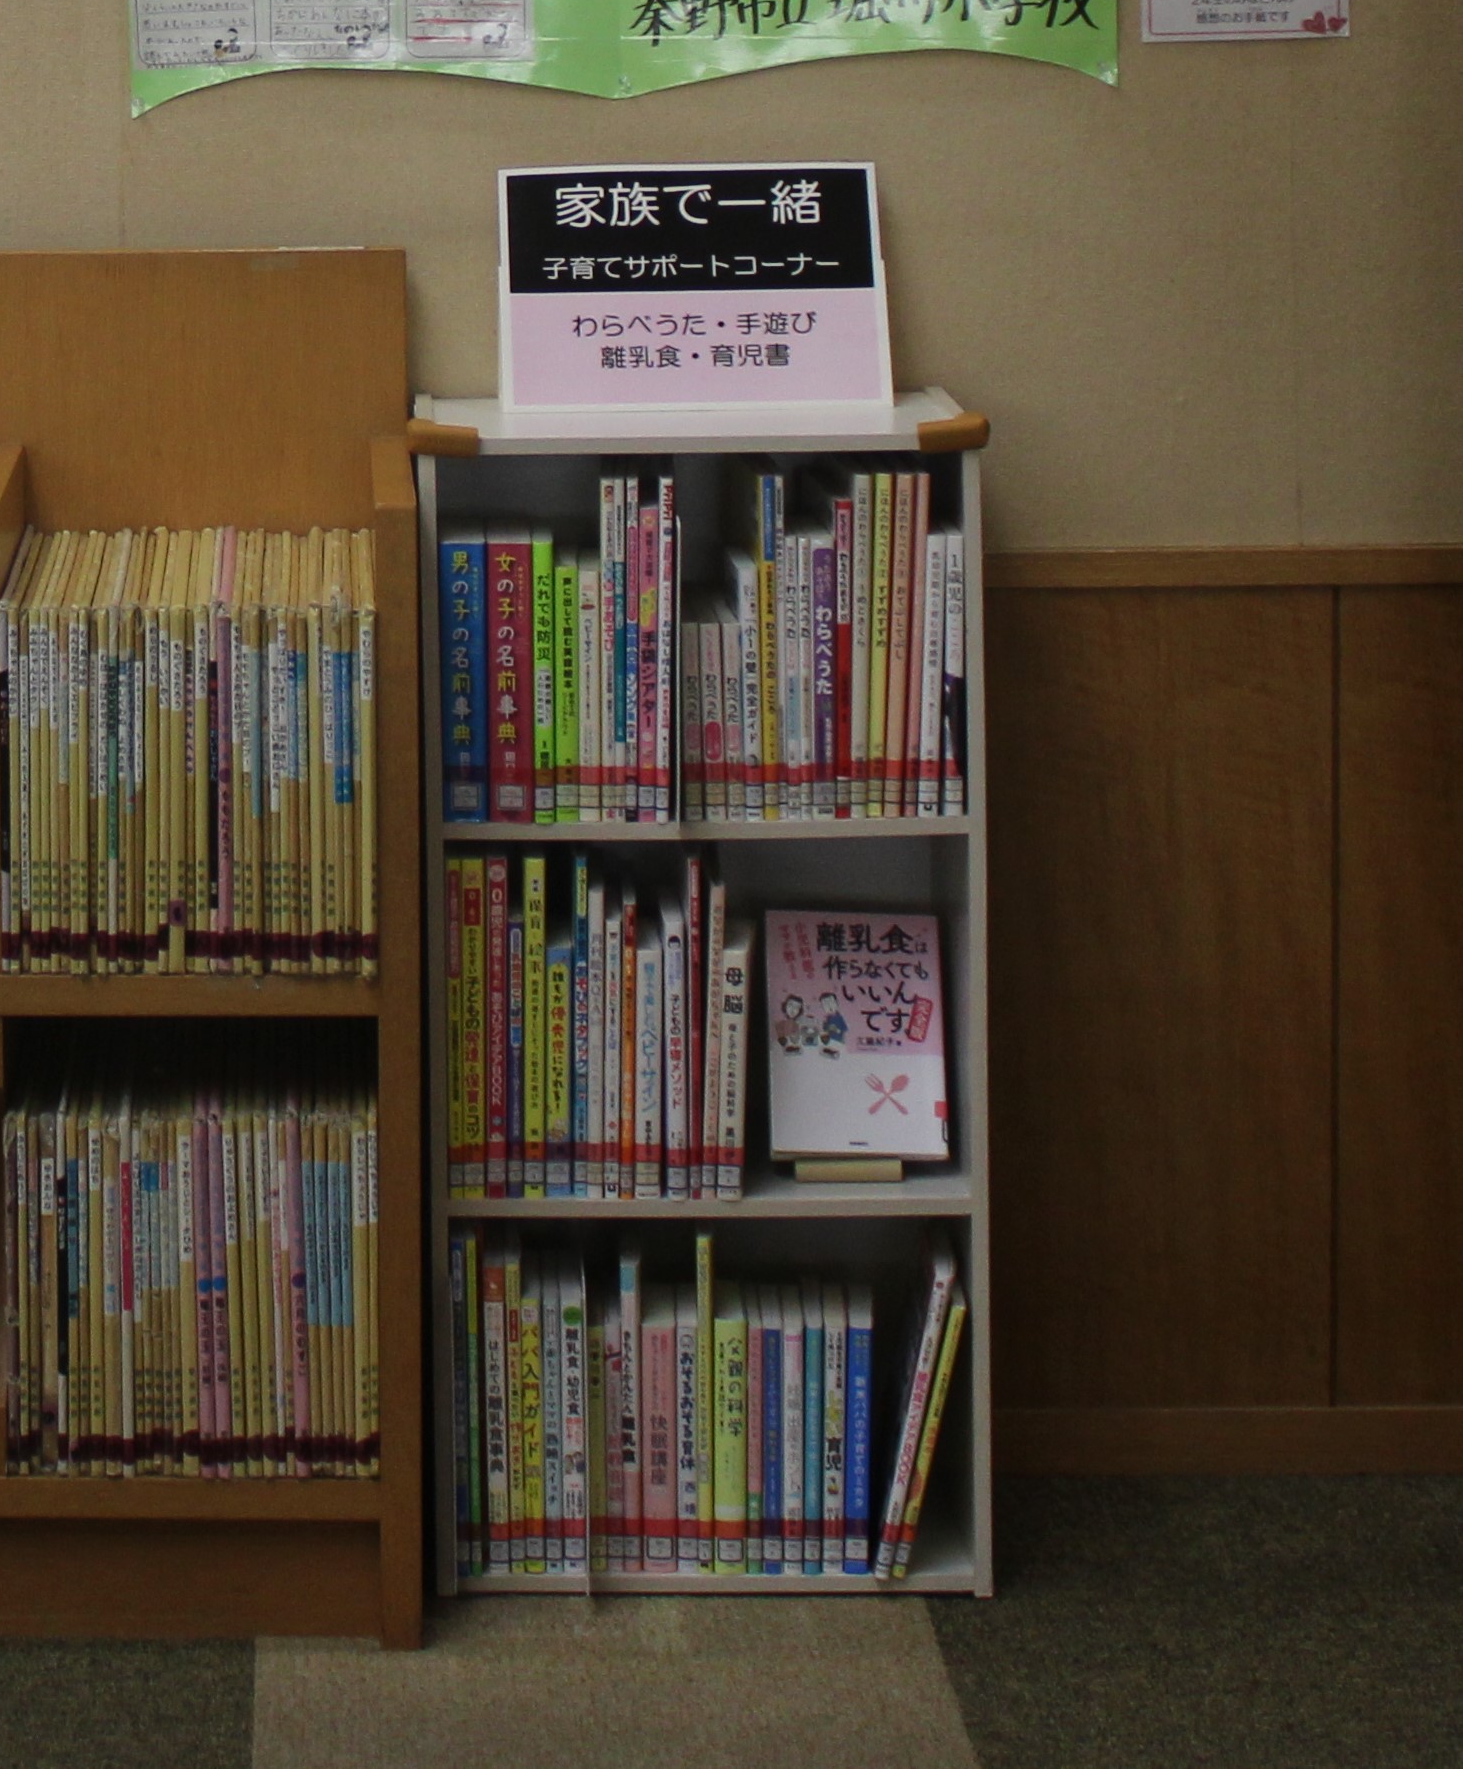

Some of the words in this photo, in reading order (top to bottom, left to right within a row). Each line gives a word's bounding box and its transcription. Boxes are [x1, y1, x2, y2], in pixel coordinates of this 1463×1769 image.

[555, 179, 823, 228] 家族で一緒
[542, 252, 840, 281] 子育てサポートコーナー
[572, 310, 817, 337] わらべうた・手遊び
[600, 342, 791, 370] 離乳食・育児書
[814, 603, 836, 696] わらべうた
[816, 923, 928, 955] 離乳食は
[822, 956, 929, 980] 作らなくても
[842, 981, 918, 1003] いいん
